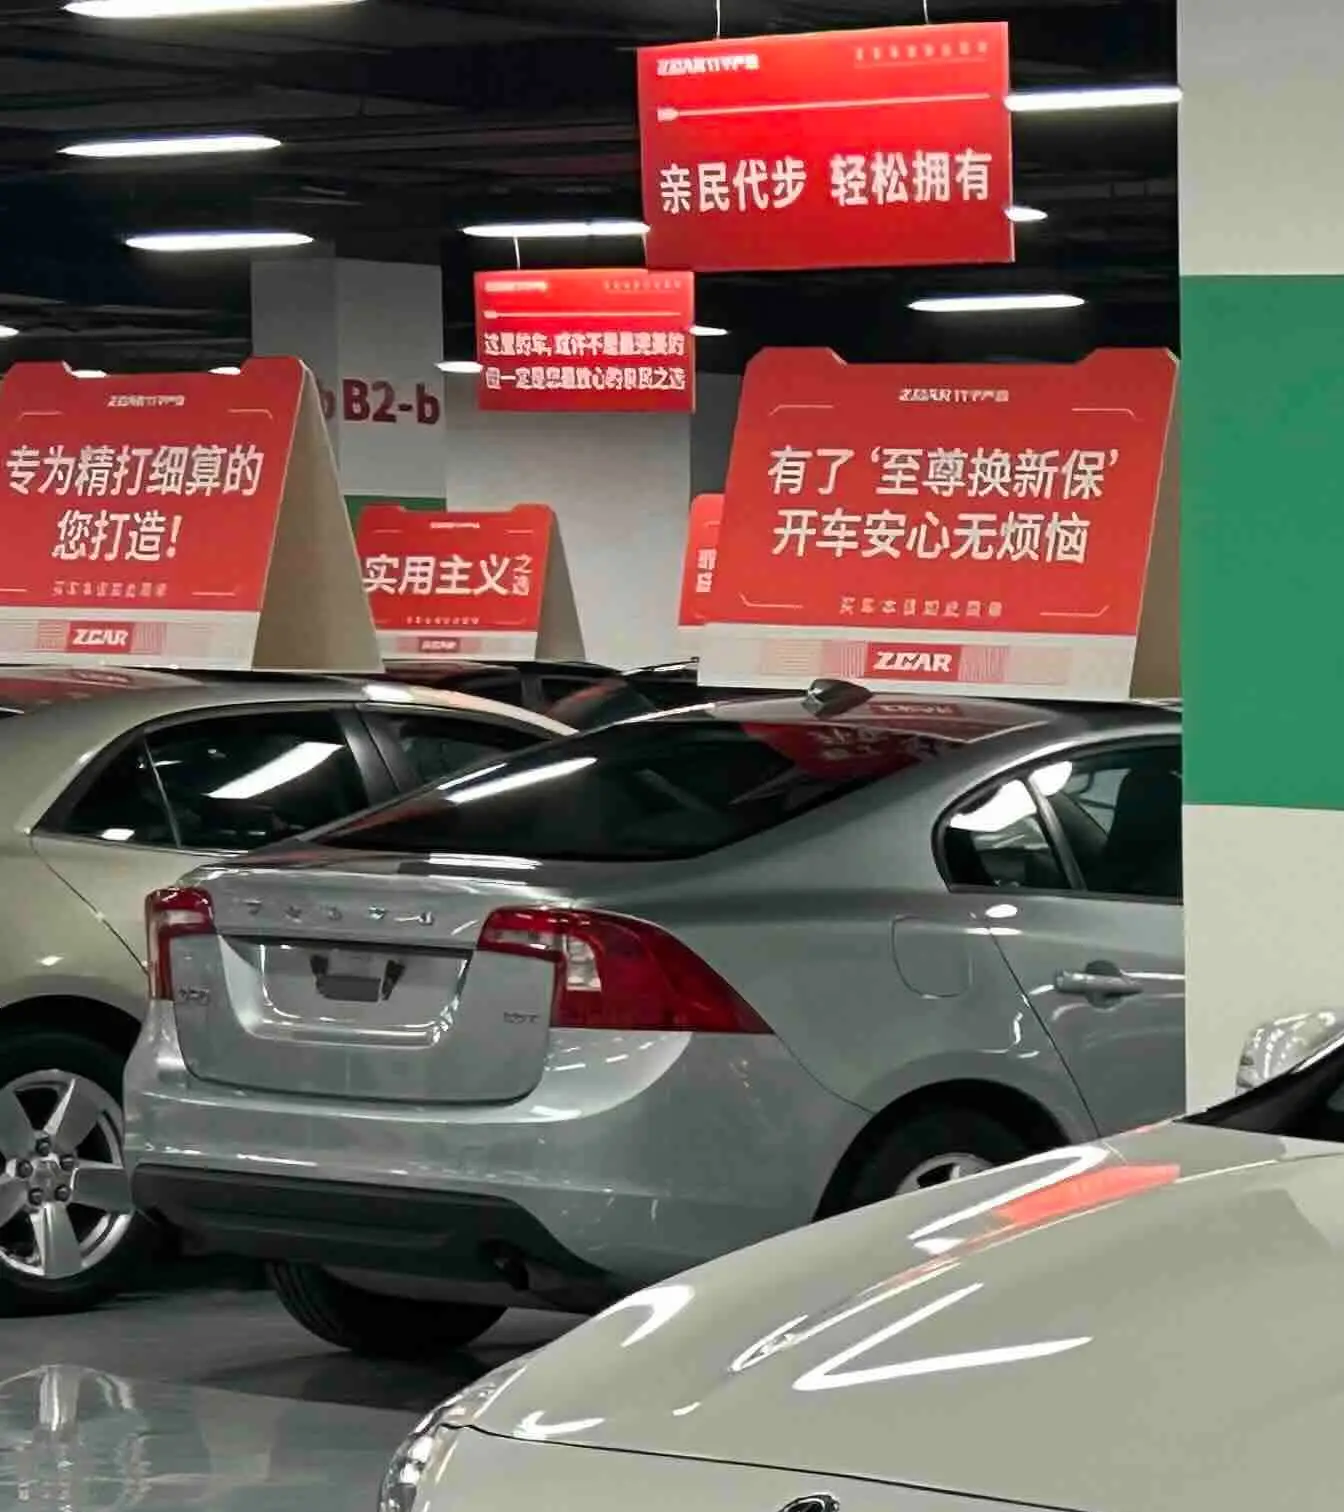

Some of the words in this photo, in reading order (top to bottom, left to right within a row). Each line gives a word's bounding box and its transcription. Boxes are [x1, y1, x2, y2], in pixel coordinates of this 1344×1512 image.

[659, 155, 807, 215] 亲民代步
[830, 148, 993, 208] 轻松拥有
[342, 379, 441, 425] B2-b
[6, 443, 265, 497] 专为精打细算的
[52, 509, 182, 561] 您打造!
[771, 508, 1091, 566] 开车安心无烦恼
[362, 553, 510, 597] 实用主义
[72, 628, 129, 646] ZCAR
[873, 651, 952, 672] ZCAR
